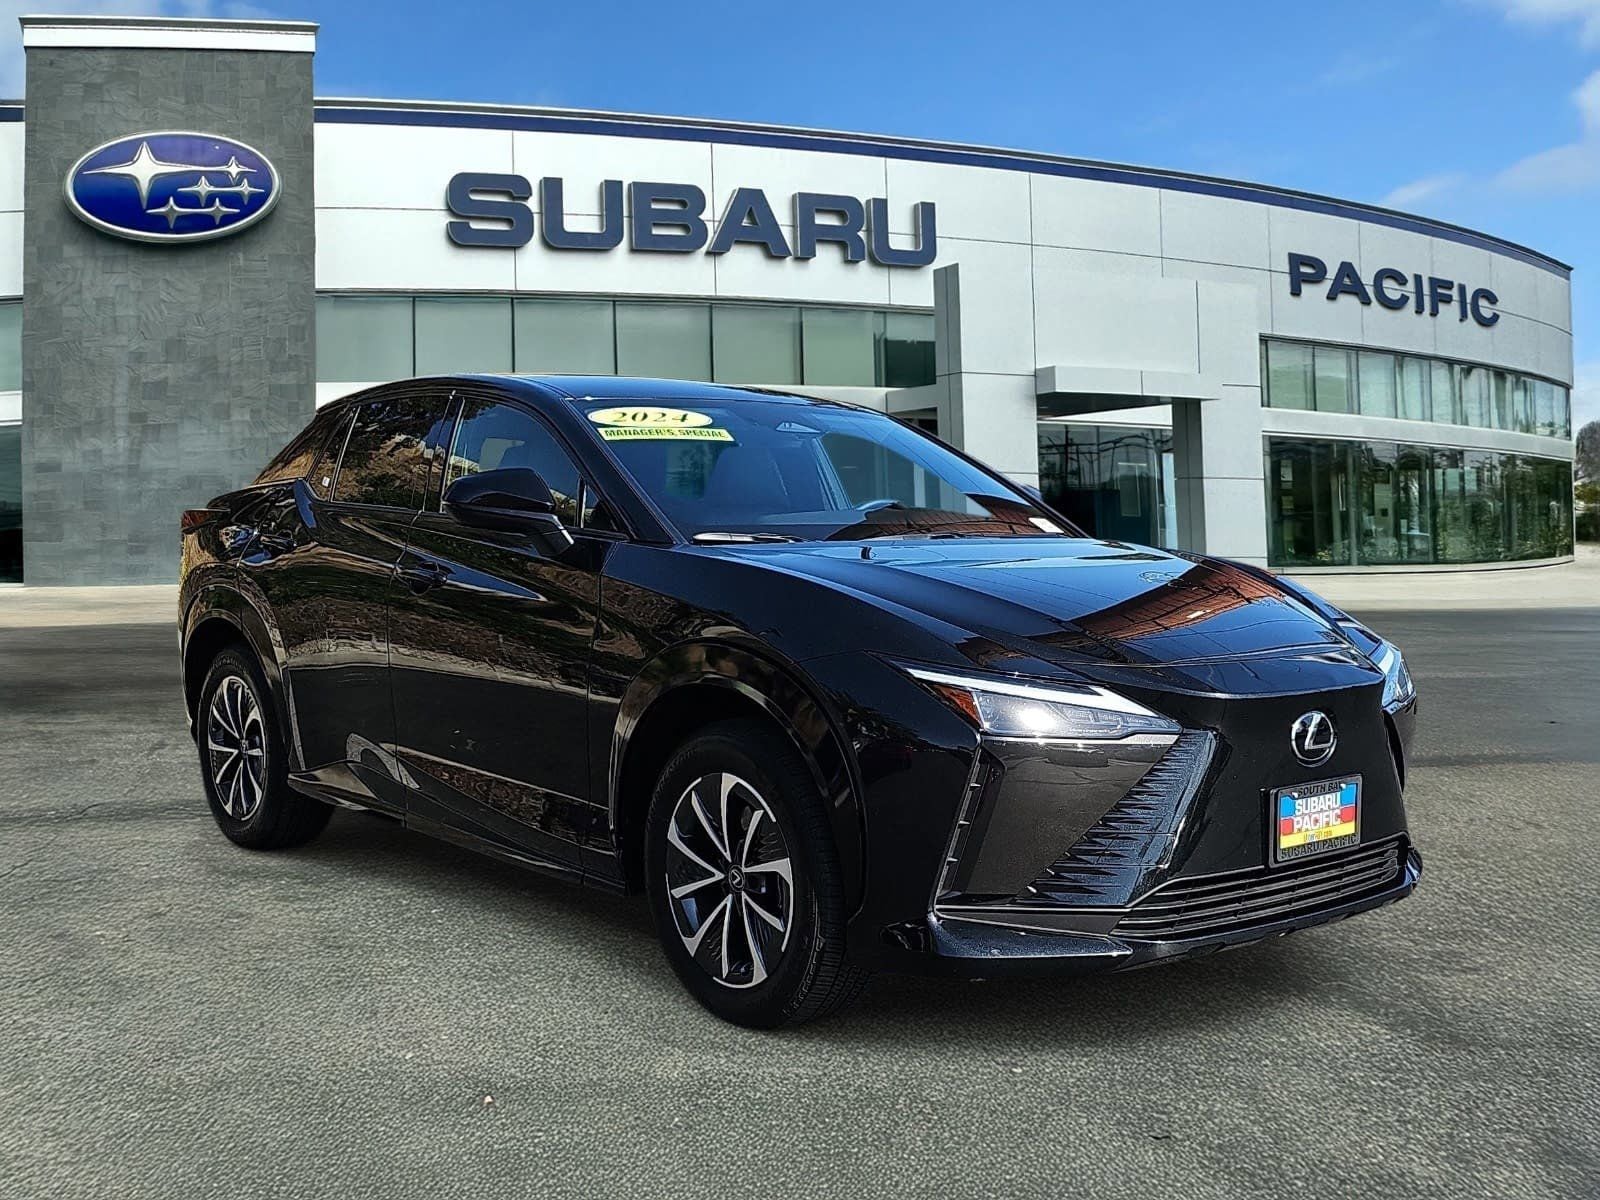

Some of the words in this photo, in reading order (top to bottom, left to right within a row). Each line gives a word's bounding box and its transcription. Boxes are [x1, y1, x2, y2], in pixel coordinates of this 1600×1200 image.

[447, 171, 937, 268] SUBARU
[1287, 252, 1500, 327] PACIFIC
[612, 411, 689, 423] 2024
[604, 428, 674, 437] MANAGER'S
[679, 429, 727, 438] SPECIAL
[1298, 784, 1326, 796] SOUTH
[1294, 792, 1340, 815] SUBARU
[1293, 810, 1341, 833] PACIFIC
[1281, 843, 1319, 859] SUBARU
